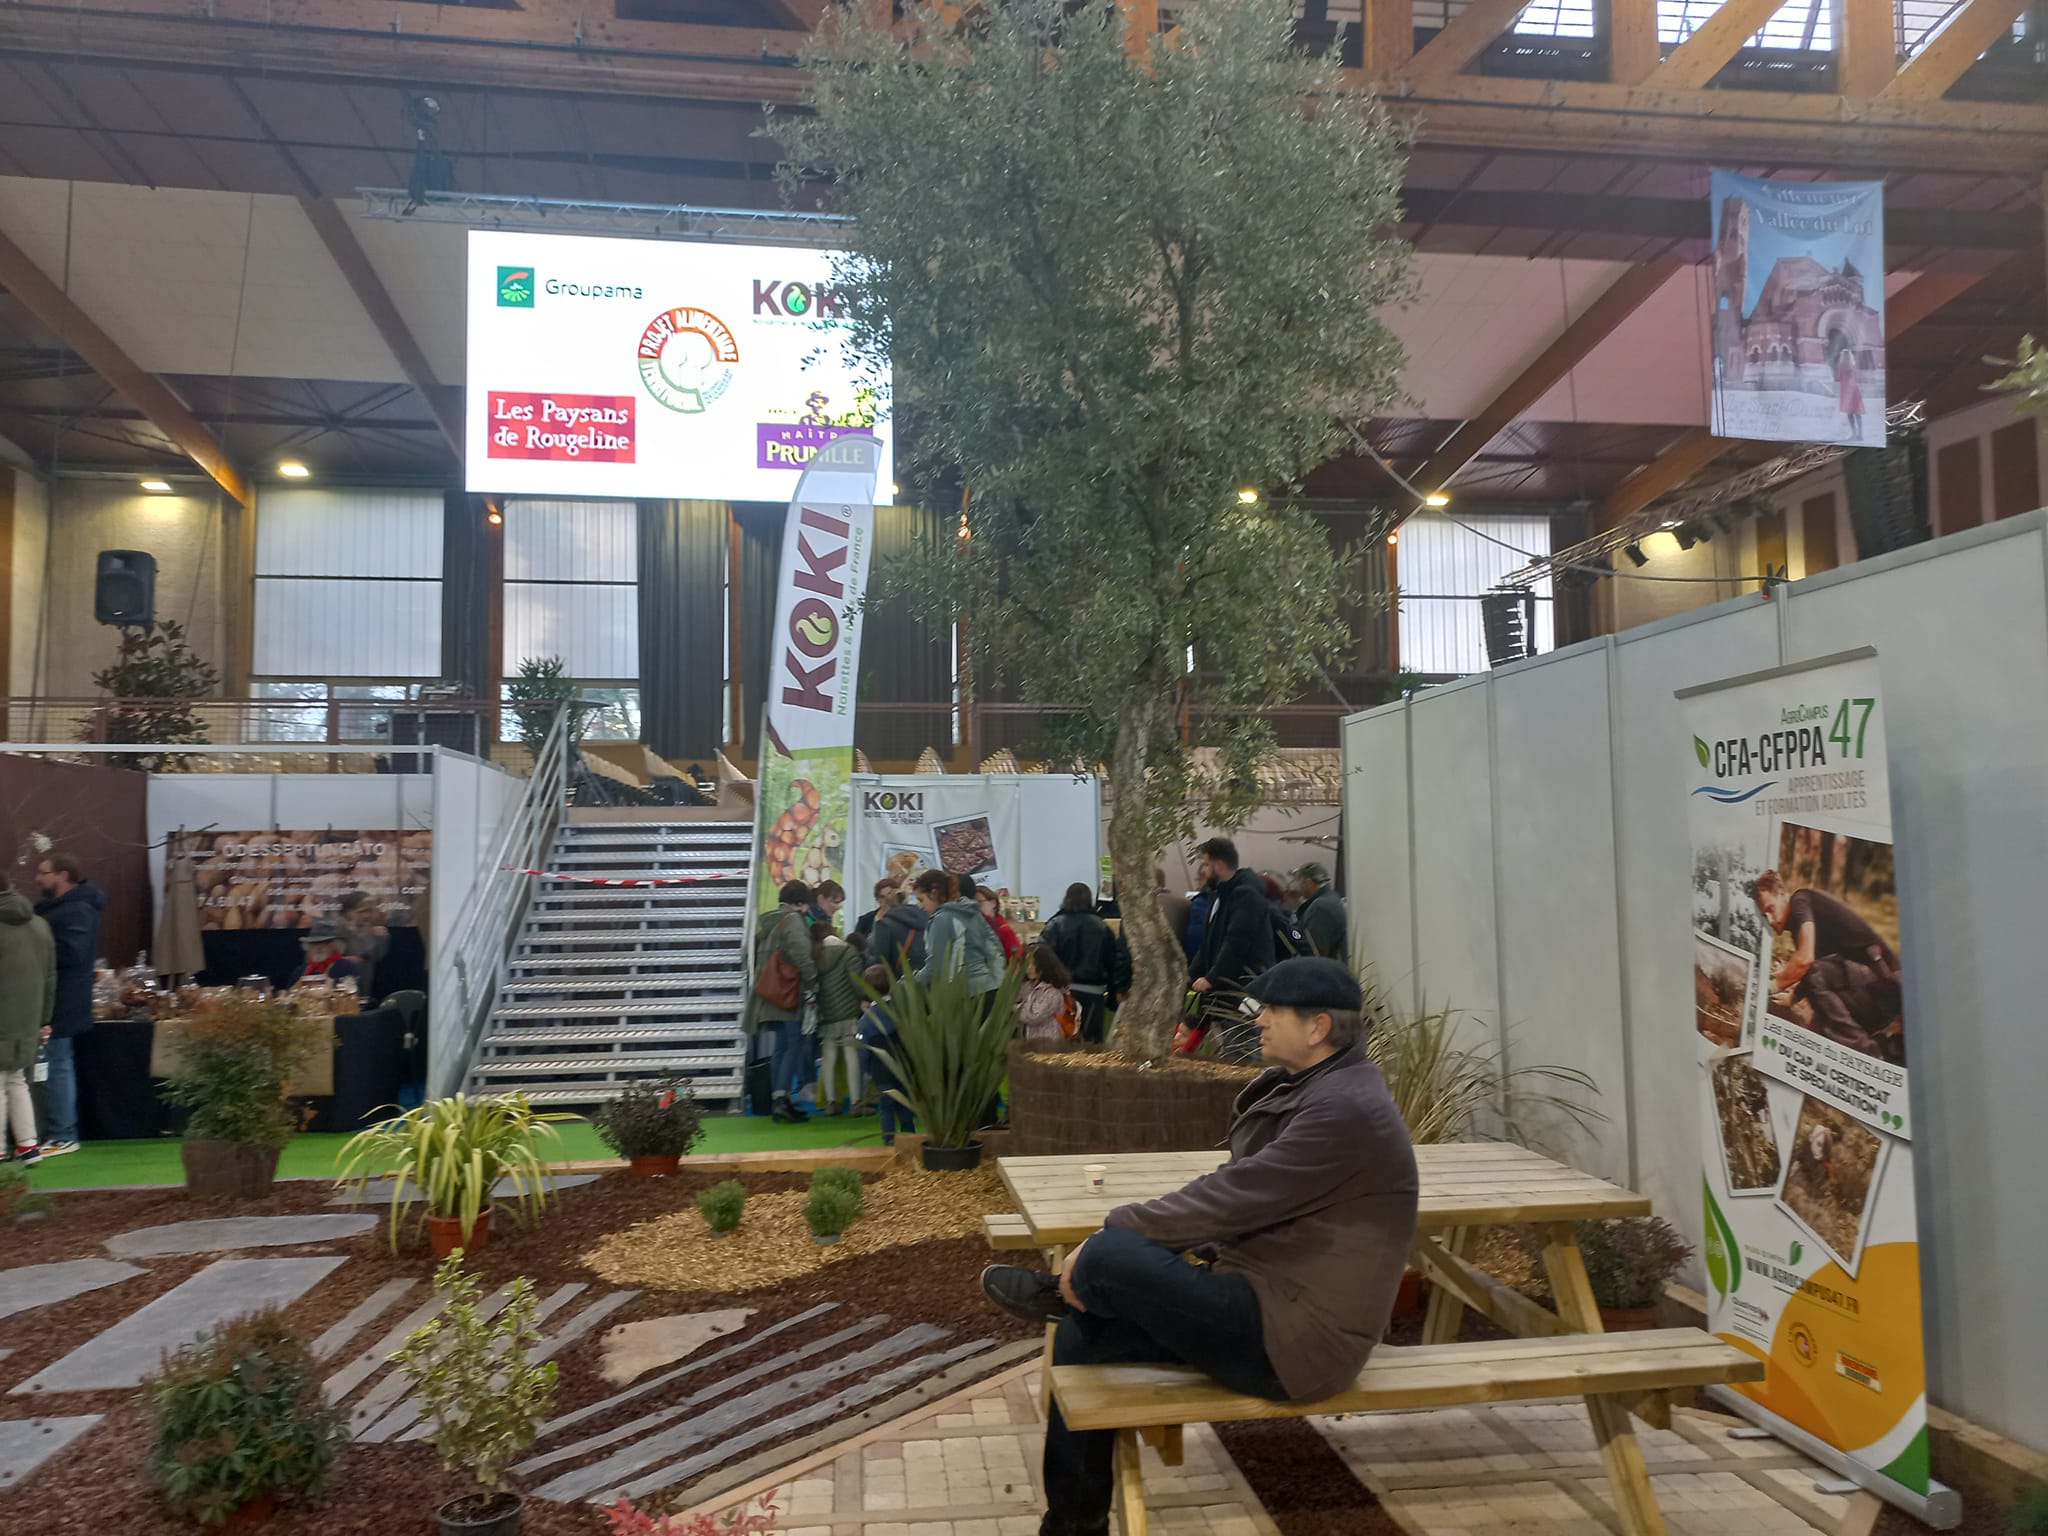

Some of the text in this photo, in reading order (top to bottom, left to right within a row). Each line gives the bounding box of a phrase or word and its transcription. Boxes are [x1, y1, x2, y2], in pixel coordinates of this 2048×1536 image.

[1814, 215, 1839, 231] du
[1843, 215, 1872, 236] Lot
[545, 278, 643, 300] Groupama
[753, 279, 852, 319] KOK
[640, 312, 677, 358] PROJET
[494, 398, 628, 428] Les Paysans
[494, 425, 629, 456] de Rougeline
[851, 527, 865, 574] France
[848, 576, 859, 597] de
[836, 650, 852, 716] Noisettes
[1828, 697, 1875, 759] 47
[1714, 725, 1827, 778] CFA-CFPPA
[1788, 769, 1865, 793] APPRENTISSAGE
[864, 791, 924, 811] KOKI
[1755, 791, 1867, 816] ET FORMATION ADULTES
[1763, 1017, 1782, 1036] Les
[1838, 1050, 1905, 1089] PAYSAGE
[1778, 1043, 1892, 1105] DU CAP AU CERTIFICAT
[1785, 1061, 1798, 1078] DE
